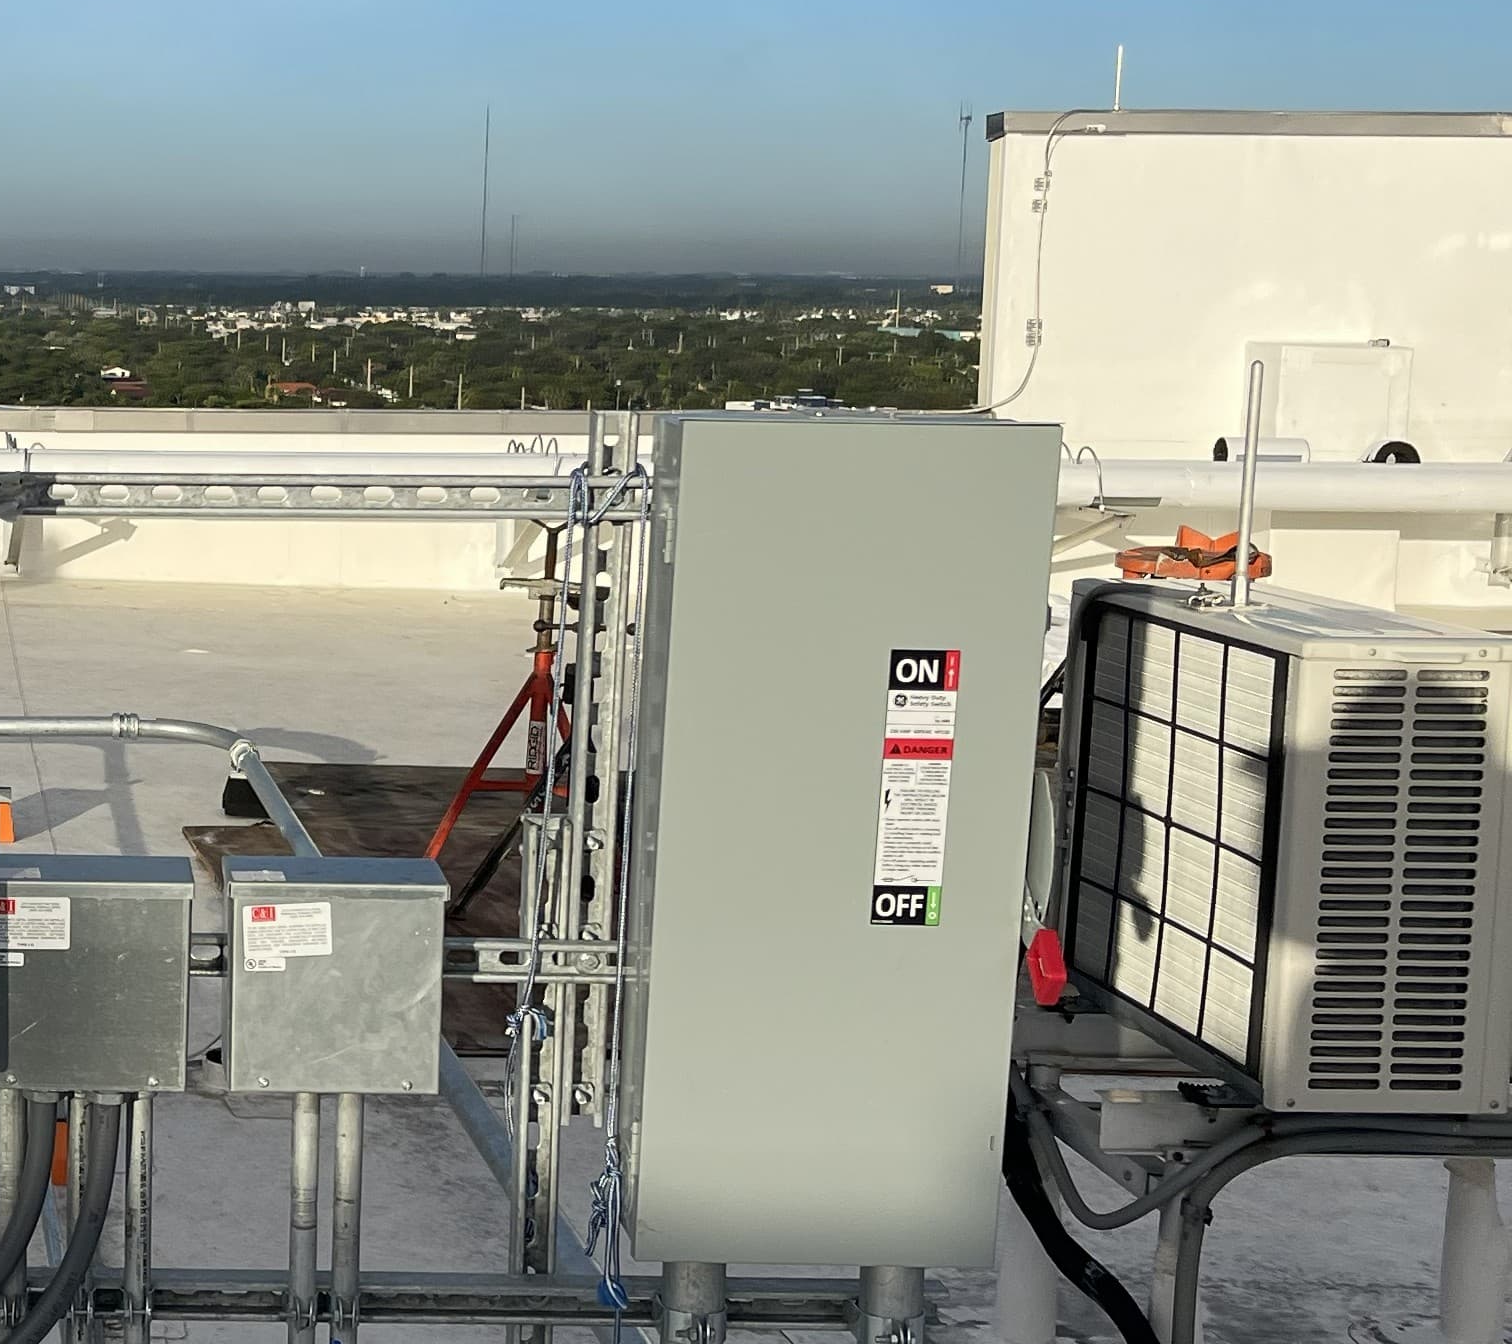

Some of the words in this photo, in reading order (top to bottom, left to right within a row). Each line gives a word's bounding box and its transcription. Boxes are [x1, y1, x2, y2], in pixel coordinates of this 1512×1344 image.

[895, 658, 940, 683] ON
[527, 725, 540, 770] RIDGID
[903, 745, 948, 755] DANGER
[875, 893, 925, 918] OFF
